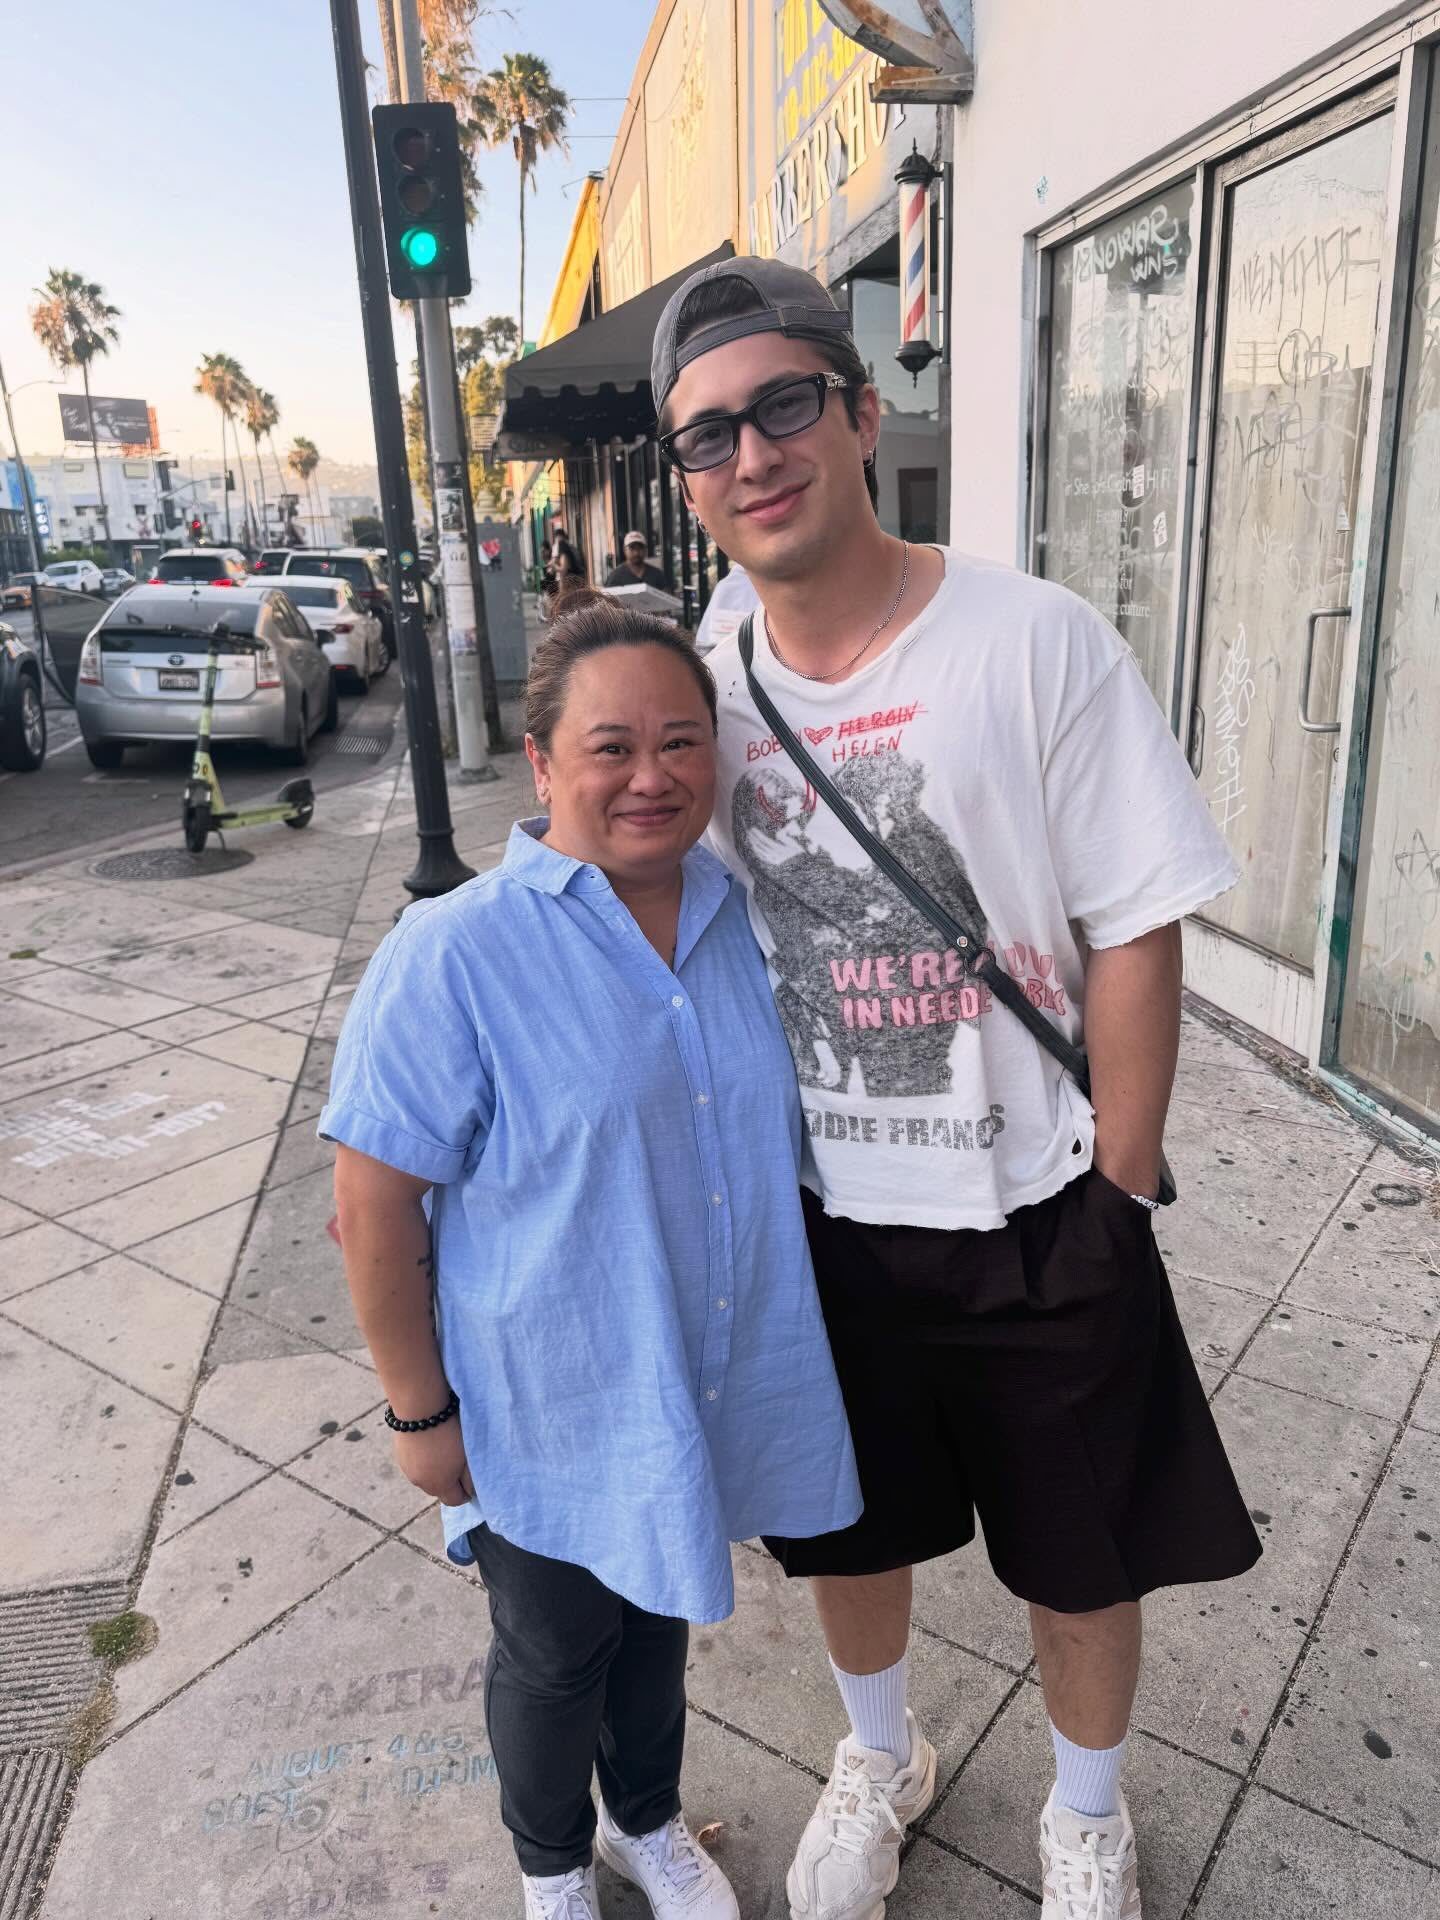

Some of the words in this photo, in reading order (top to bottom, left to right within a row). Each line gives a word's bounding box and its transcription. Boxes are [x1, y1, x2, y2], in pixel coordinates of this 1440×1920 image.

[750, 52, 906, 258] BARBERSHO
[747, 727, 804, 763] BOBY
[832, 729, 904, 763] HELEN
[829, 948, 965, 992] WE'RE
[842, 997, 884, 1030] IN
[889, 983, 993, 1028] NEEDE
[803, 1107, 877, 1144] DDIE
